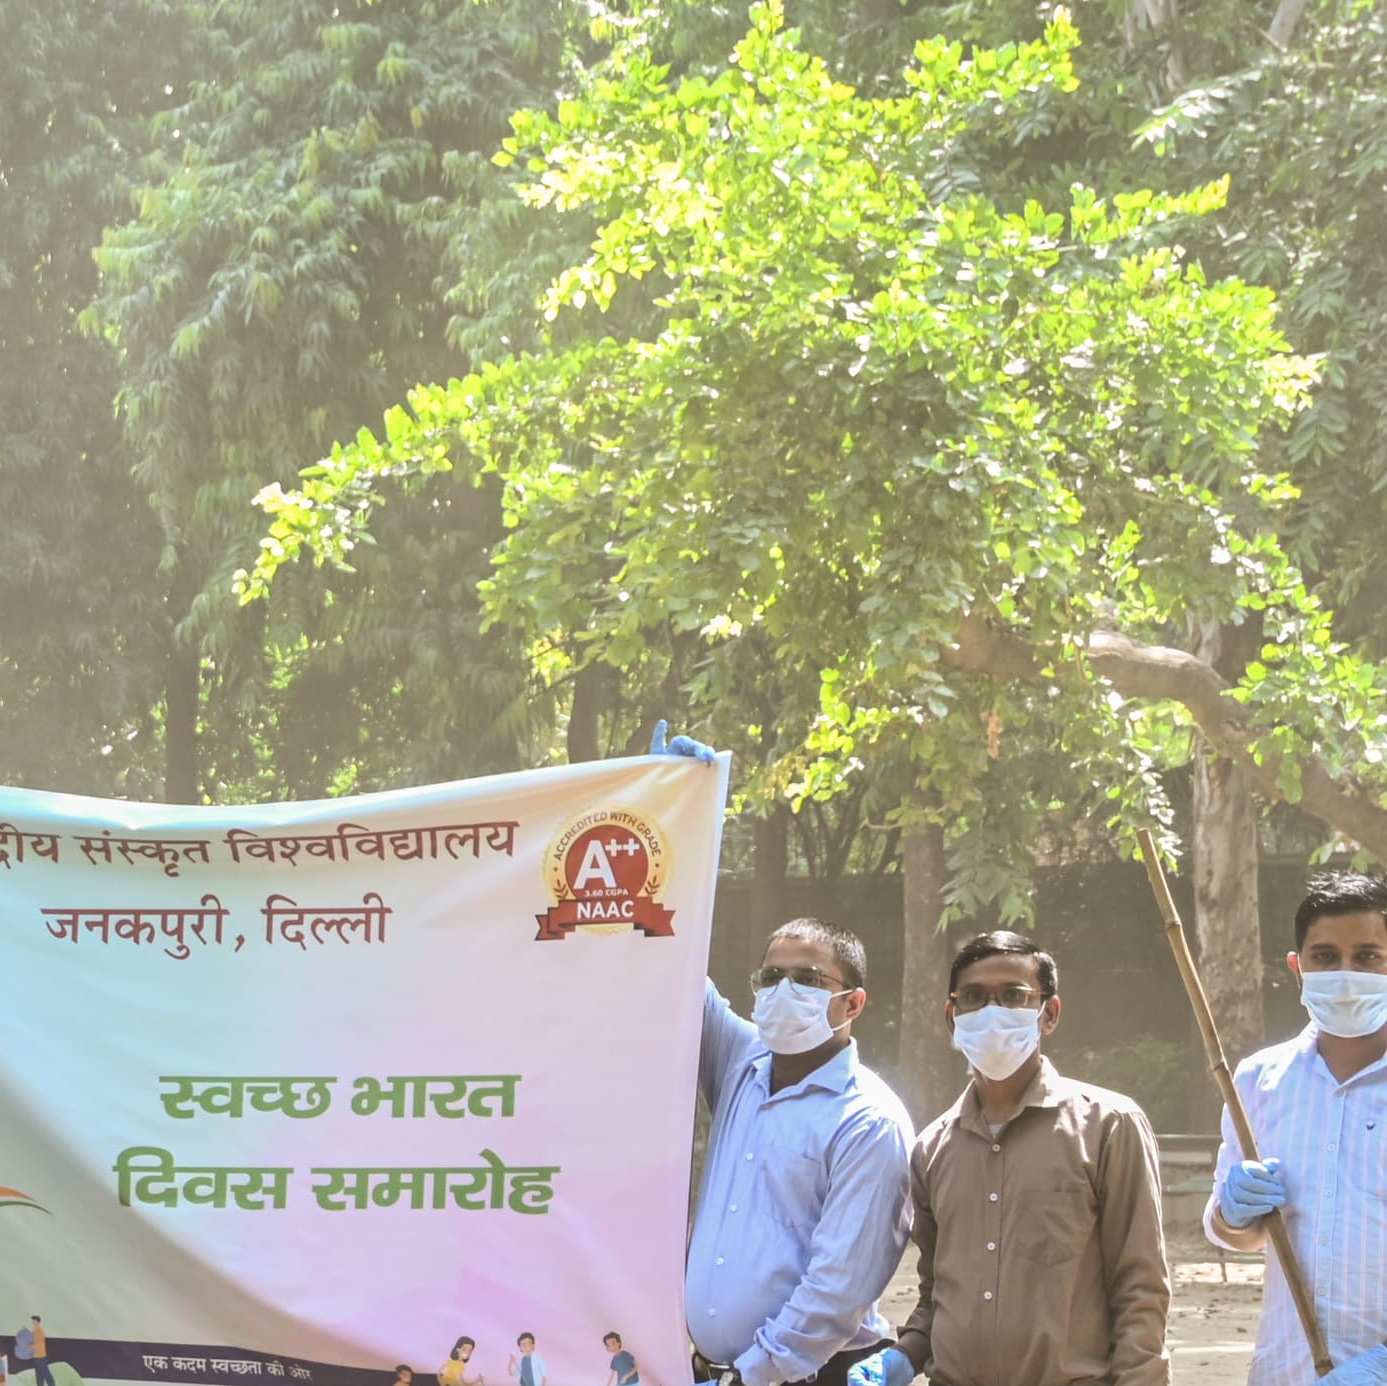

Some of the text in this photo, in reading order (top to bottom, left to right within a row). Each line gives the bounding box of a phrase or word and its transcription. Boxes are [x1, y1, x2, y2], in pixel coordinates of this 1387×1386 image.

[72, 829, 212, 878] संस्कृत
[222, 820, 521, 867] विश्वविद्यालय
[554, 811, 661, 860] ACCREDITED WITH GRADE
[573, 838, 640, 889] A++
[577, 901, 634, 919] NAAC
[584, 887, 629, 898] 3.60 CGPA
[40, 891, 394, 961] जनकपुरी, दिल्ली
[158, 1073, 522, 1120] स्वच्छ भारत
[112, 1145, 561, 1215] दिवस समारोह
[141, 1355, 169, 1373] एक
[171, 1356, 207, 1374] कदम
[210, 1358, 263, 1376] स्वच्छता
[288, 1363, 314, 1382] ओर
